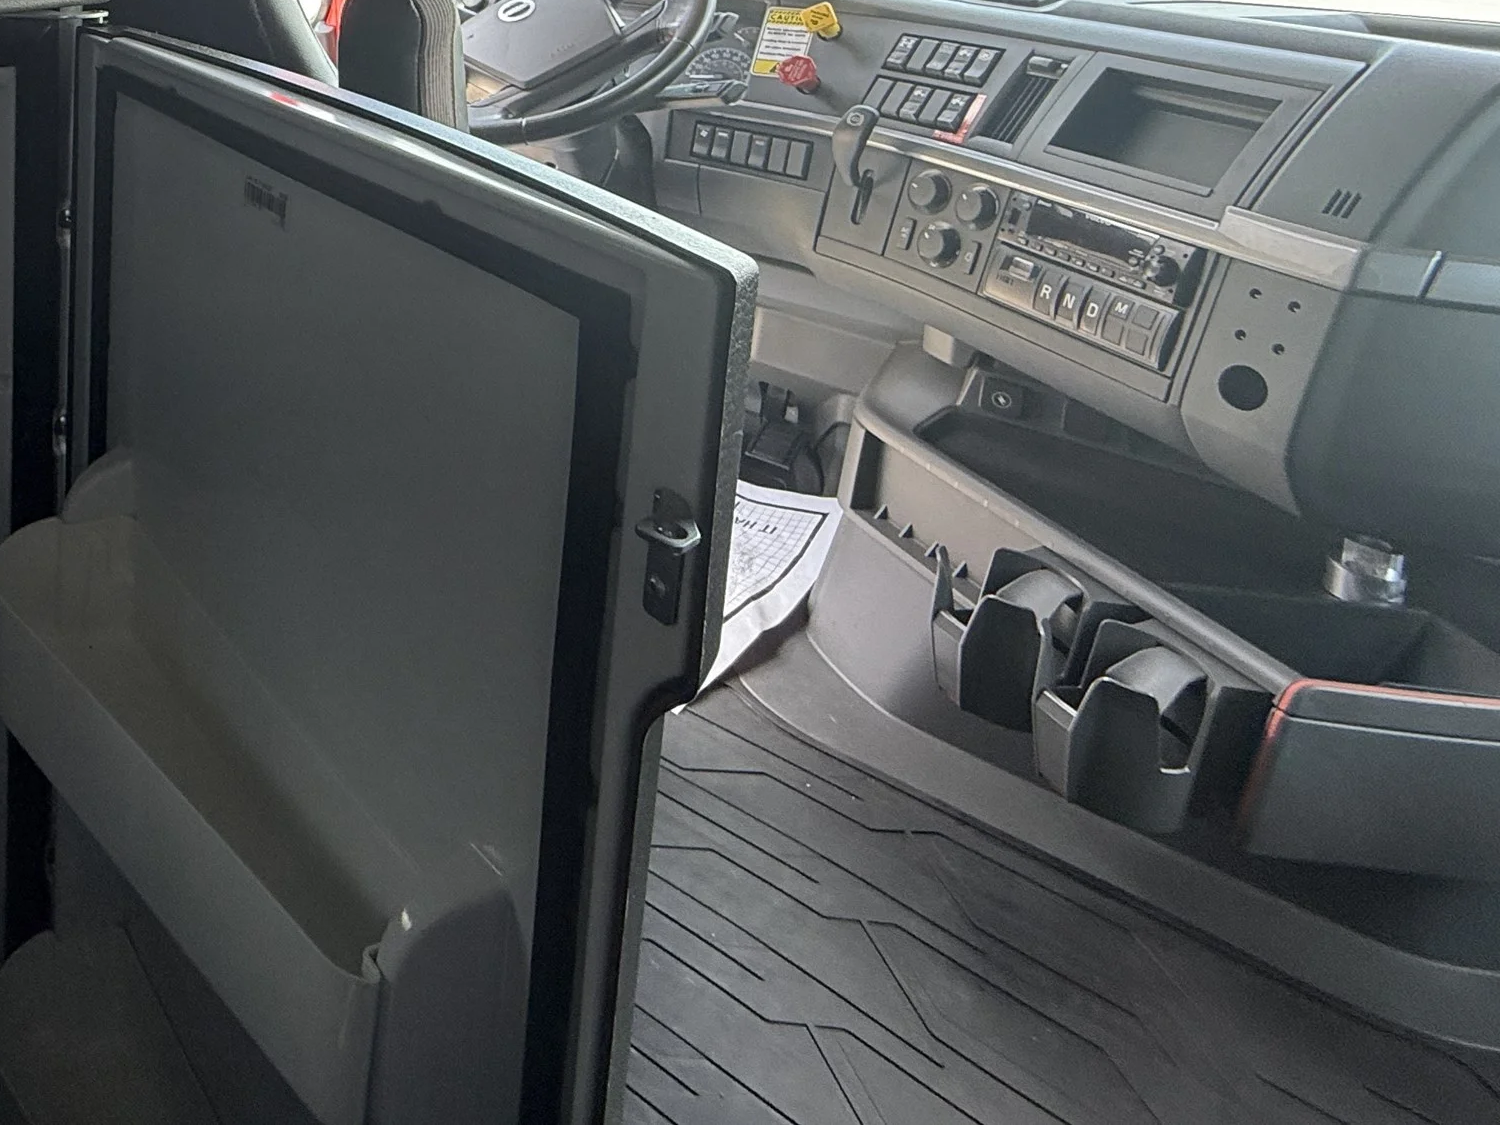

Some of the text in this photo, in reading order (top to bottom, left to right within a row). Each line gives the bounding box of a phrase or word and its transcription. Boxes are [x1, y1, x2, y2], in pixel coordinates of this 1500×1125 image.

[770, 14, 804, 22] CAUTI
[1039, 284, 1052, 299] R
[1062, 293, 1076, 309] N
[1114, 301, 1128, 315] M
[1086, 302, 1099, 318] D
